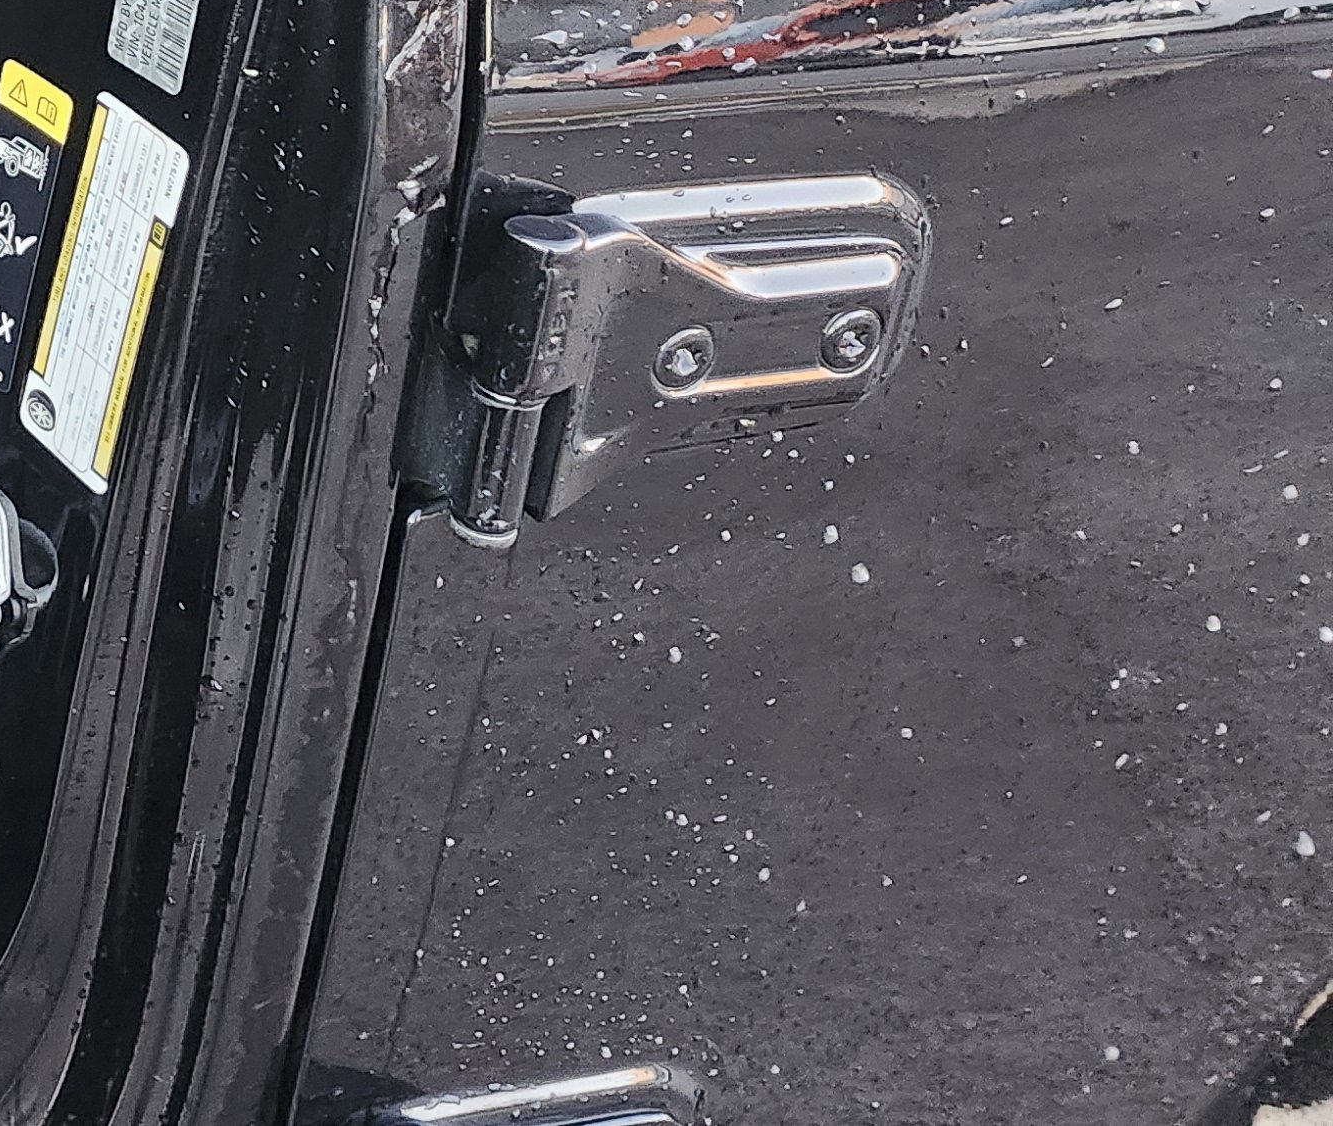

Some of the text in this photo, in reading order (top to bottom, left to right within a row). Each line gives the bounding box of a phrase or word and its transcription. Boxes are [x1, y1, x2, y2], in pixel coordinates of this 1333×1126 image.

[114, 19, 128, 52] MFD
[126, 29, 140, 59] VIN:
[140, 11, 159, 67] VEHICLE
[163, 150, 181, 199] NW275173
